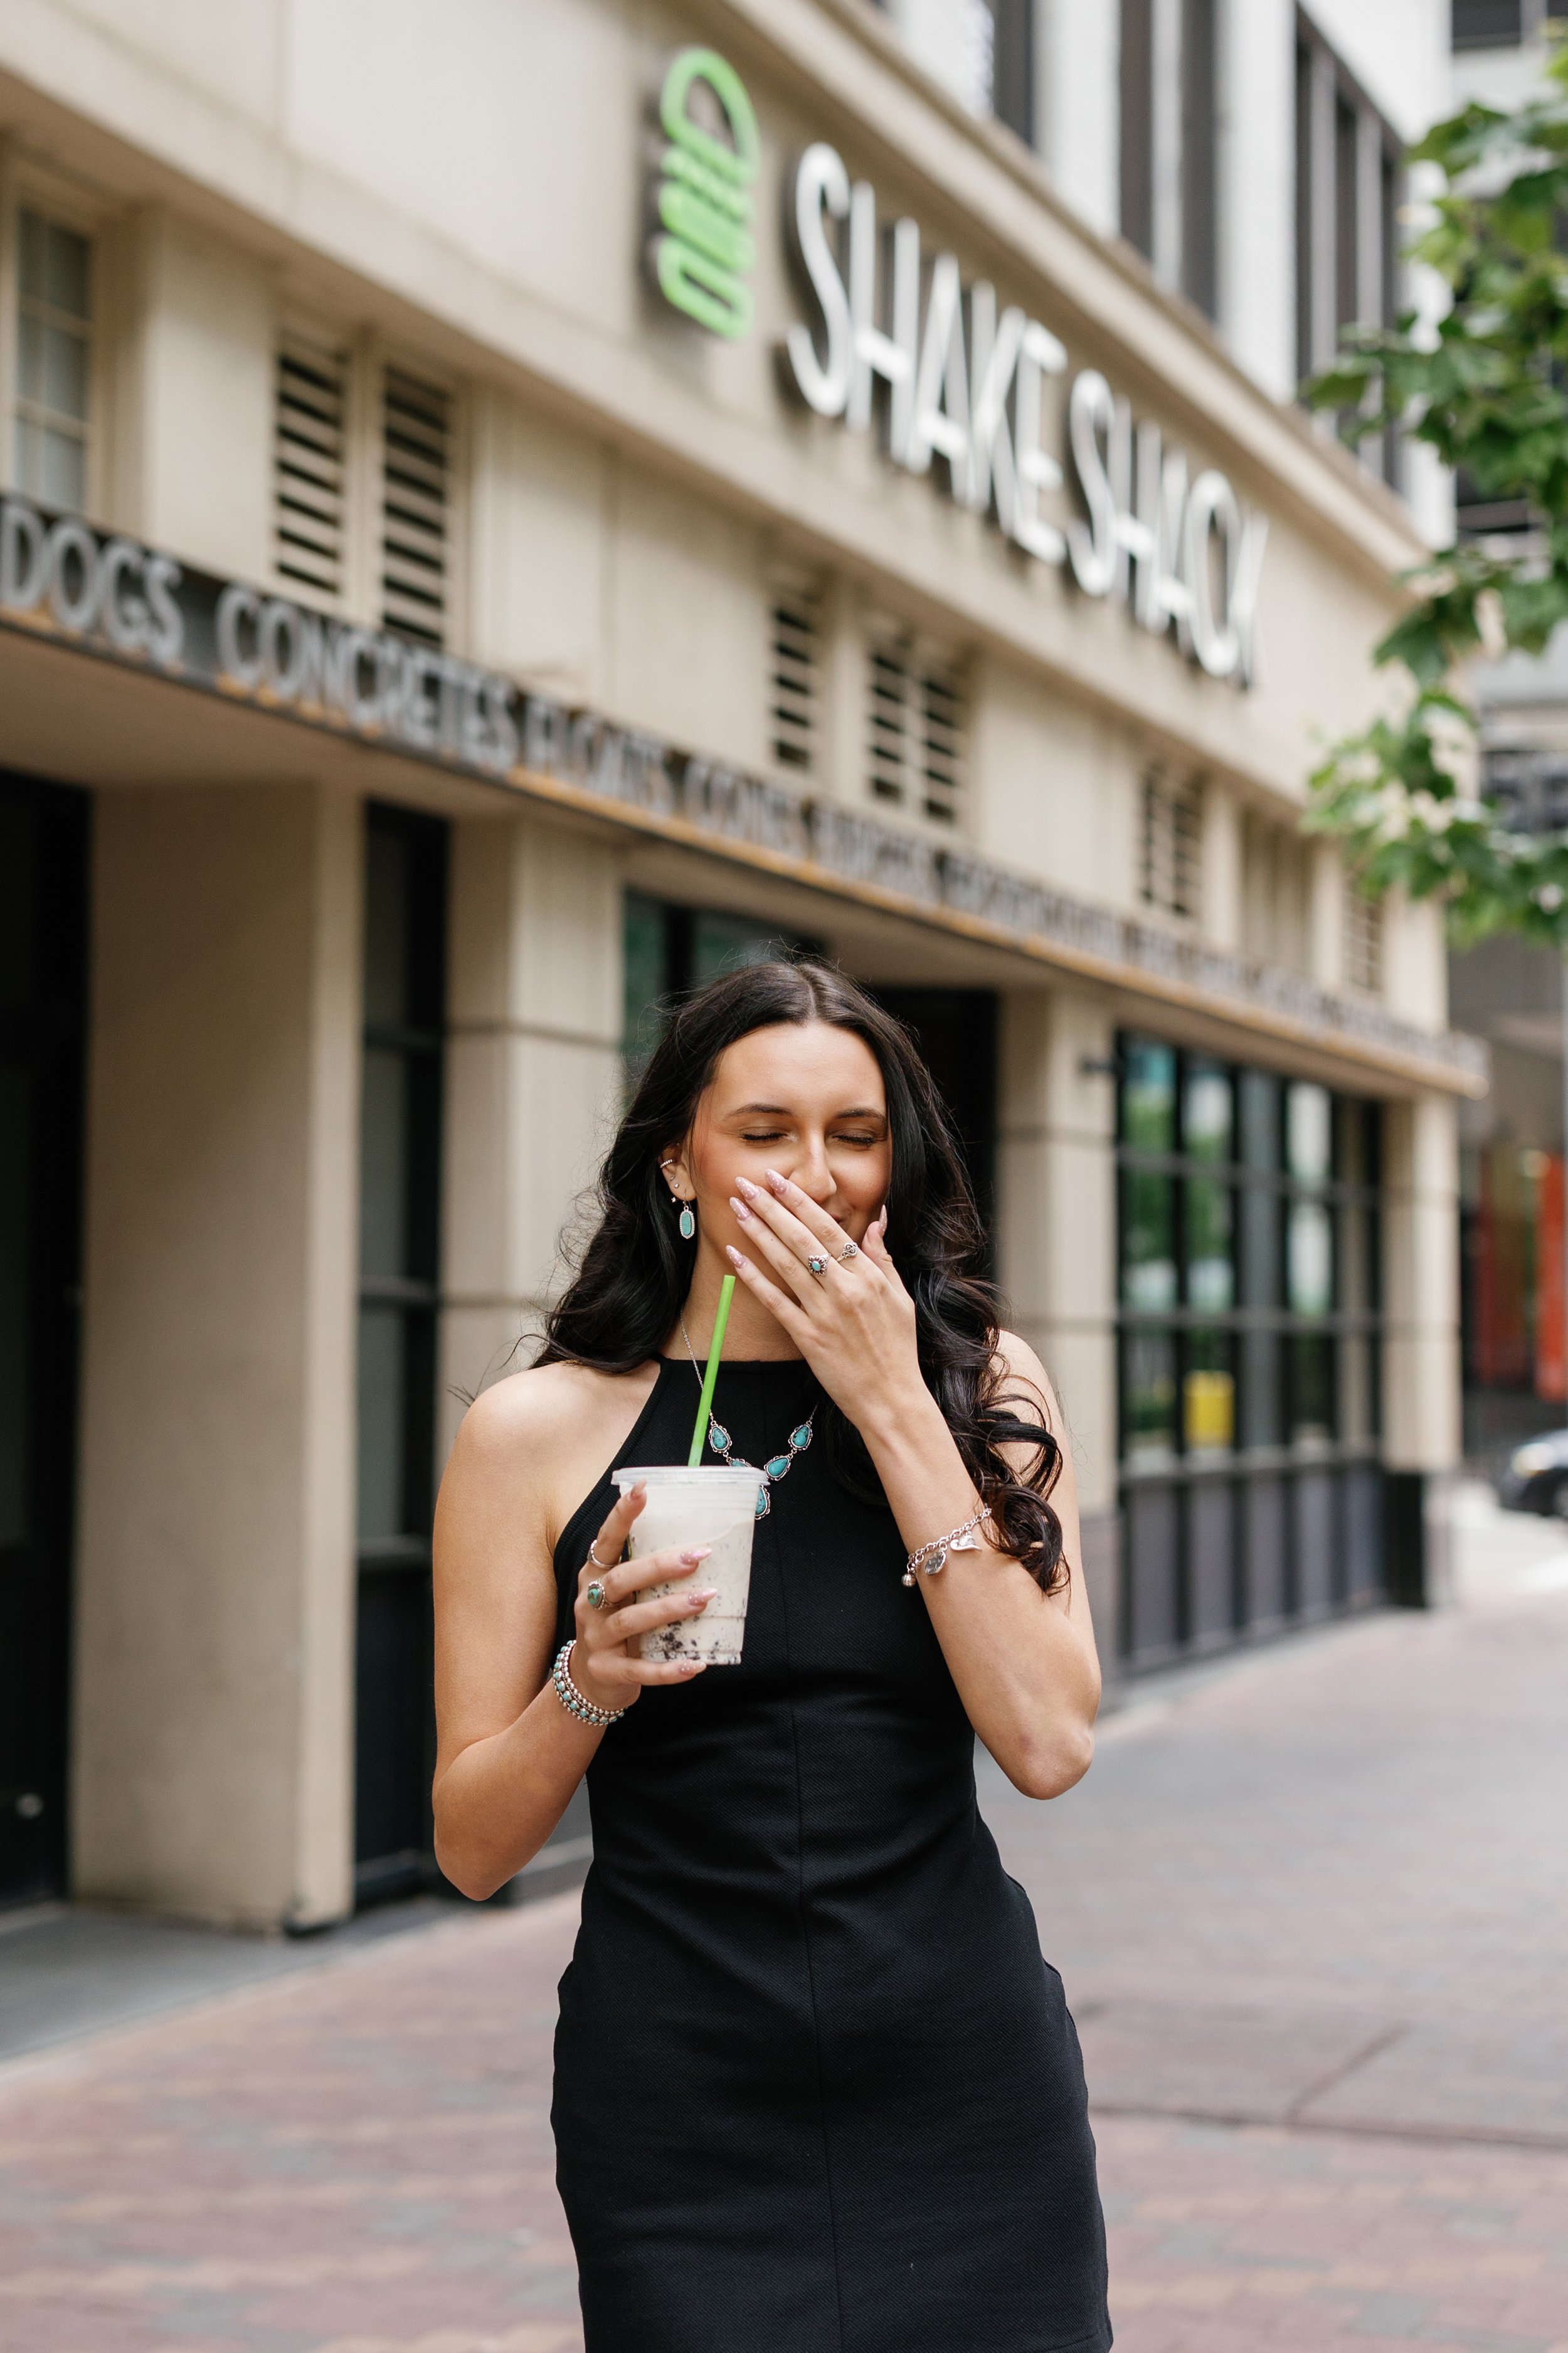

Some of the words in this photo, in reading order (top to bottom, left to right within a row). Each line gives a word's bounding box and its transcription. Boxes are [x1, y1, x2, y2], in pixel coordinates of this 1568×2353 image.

[787, 142, 1067, 565] SHAKE
[1066, 368, 1269, 692] SHACK
[0, 504, 184, 665] DOGS
[216, 583, 518, 776] CONCRETES
